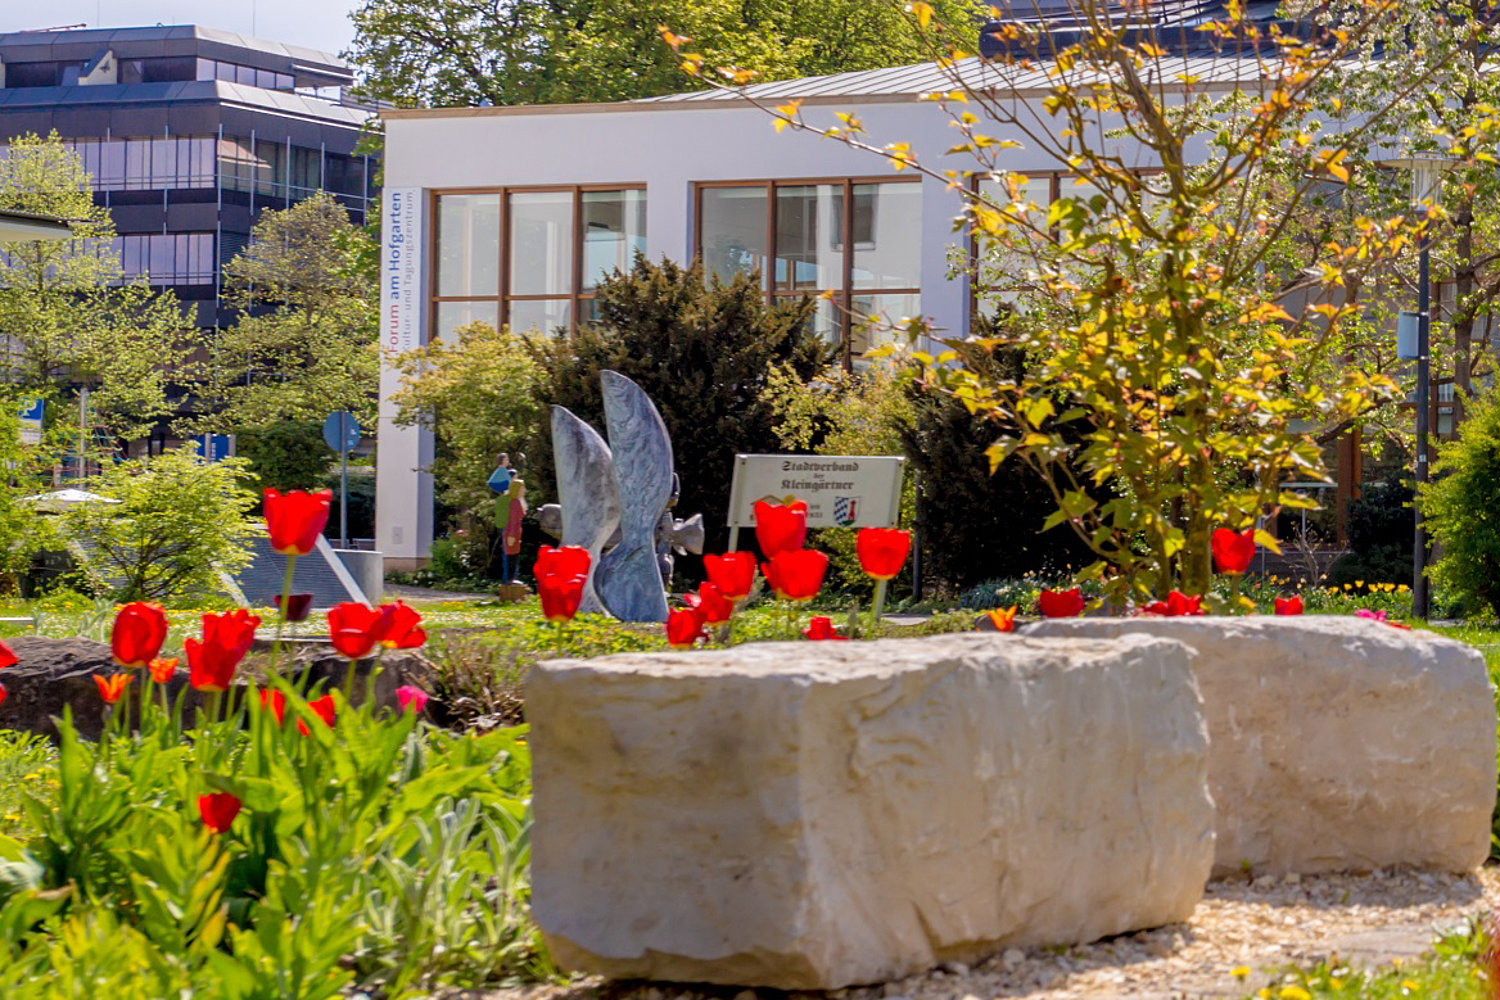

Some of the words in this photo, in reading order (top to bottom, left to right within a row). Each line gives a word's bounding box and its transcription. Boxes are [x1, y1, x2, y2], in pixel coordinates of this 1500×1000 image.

[388, 192, 404, 271] Hofgarten
[404, 191, 415, 286] Tagungszentrum
[391, 275, 400, 300] am
[403, 289, 412, 311] und
[388, 304, 400, 353] Forum
[781, 460, 859, 472] Stadtverband
[780, 479, 854, 493] Kleingärtner
